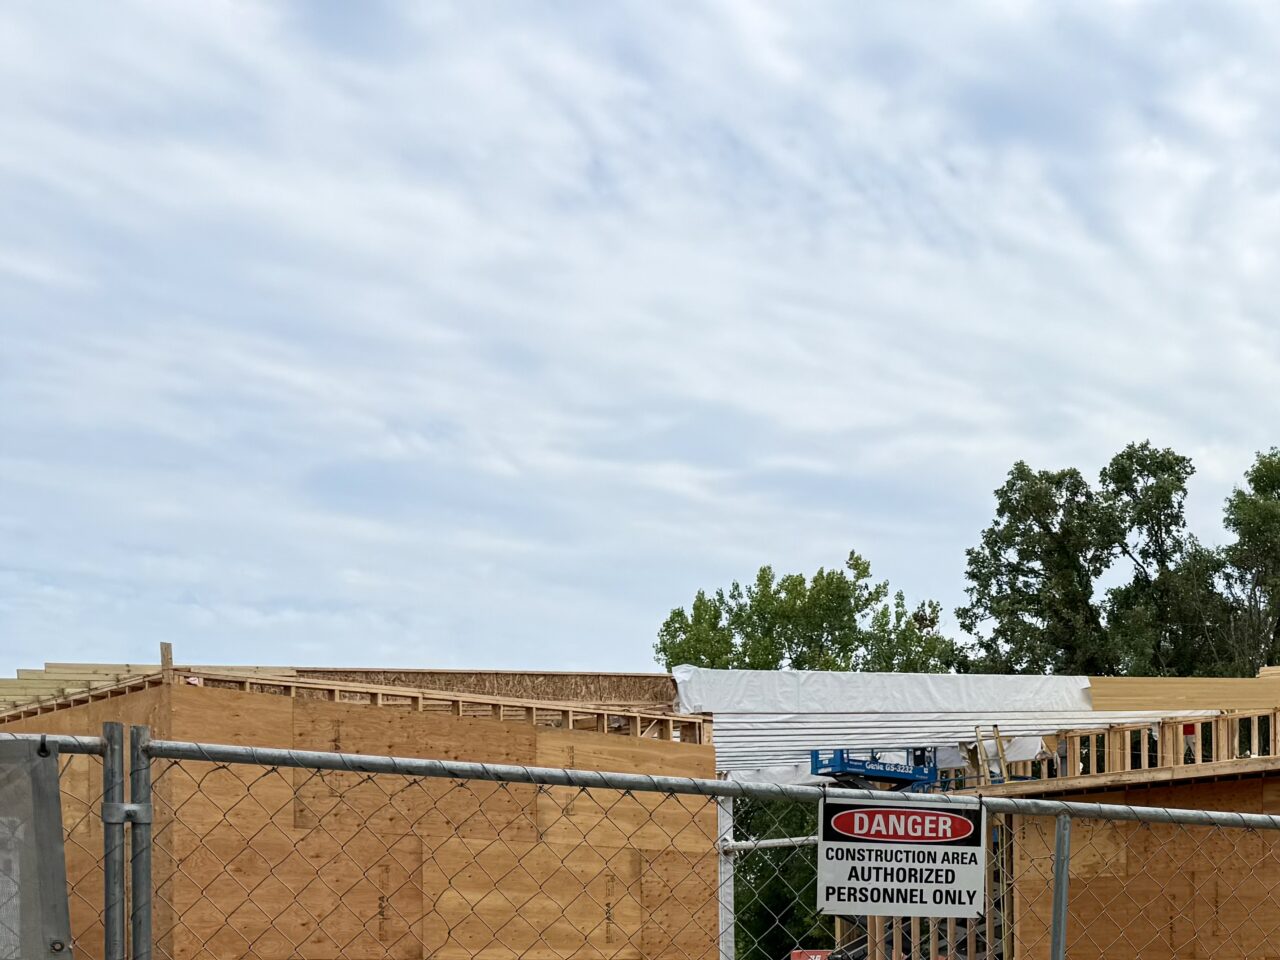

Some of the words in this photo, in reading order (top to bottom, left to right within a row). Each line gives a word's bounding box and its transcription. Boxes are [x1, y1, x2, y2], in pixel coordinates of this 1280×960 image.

[865, 761, 883, 771] Genie
[885, 763, 914, 774] GS-3232
[853, 813, 952, 838] DANGER
[825, 847, 937, 864] CONSTRUCTION
[941, 851, 978, 865] AREA
[847, 866, 956, 884] AUTHORIZED
[825, 886, 927, 904] PERSONNEL
[932, 889, 977, 905] ONLY
